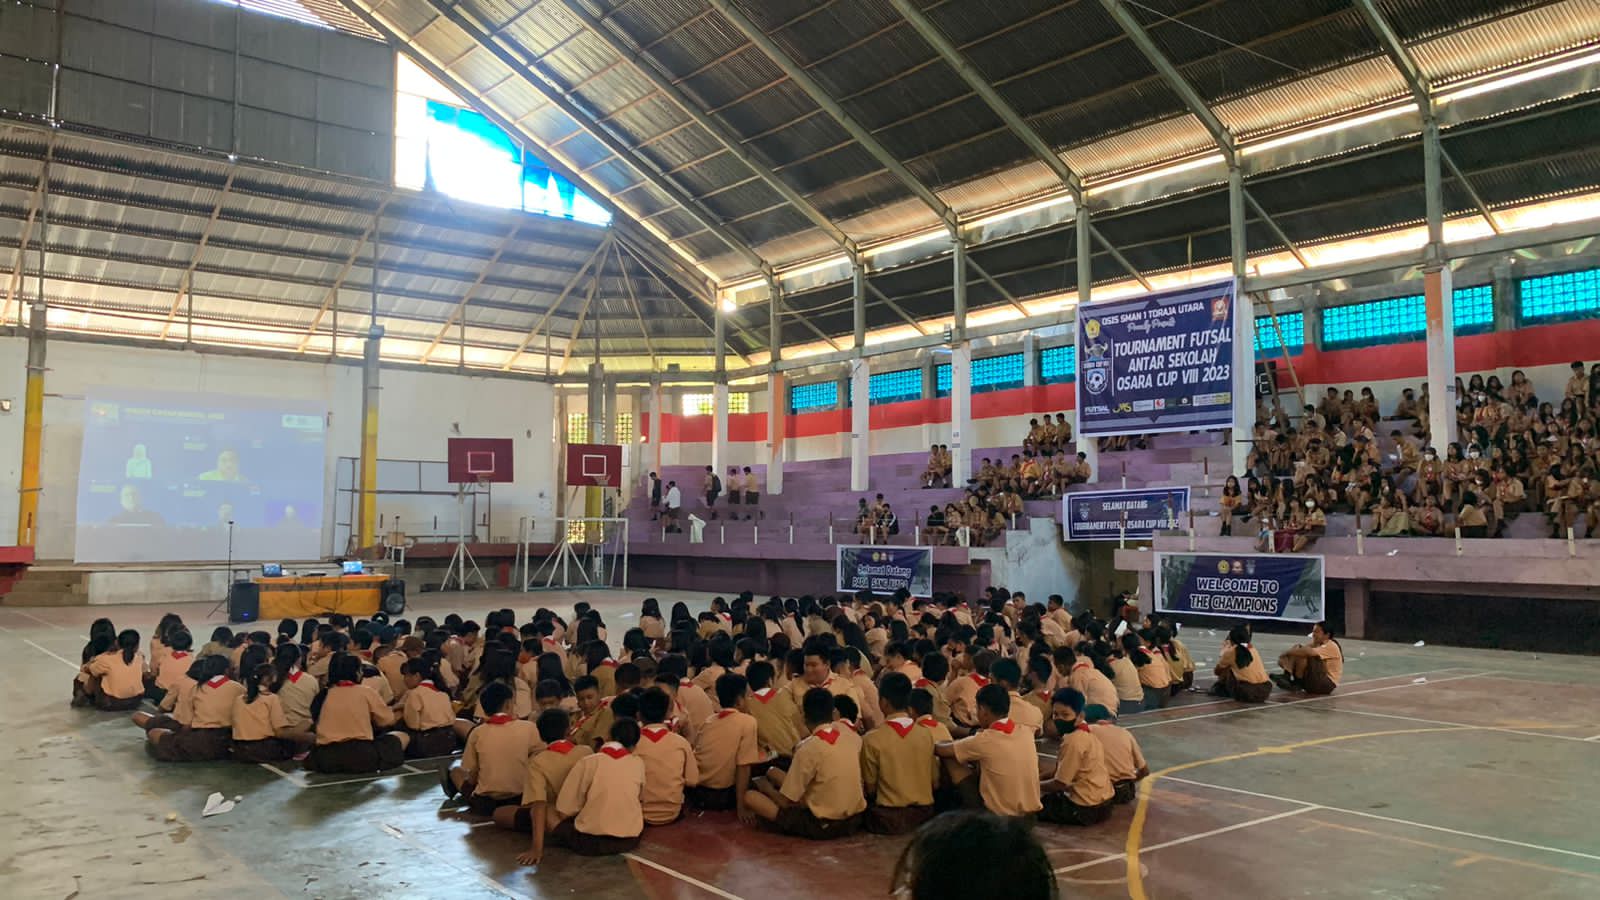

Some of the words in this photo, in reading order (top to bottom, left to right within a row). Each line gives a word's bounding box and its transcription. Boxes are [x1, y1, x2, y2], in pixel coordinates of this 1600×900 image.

[1102, 315, 1119, 326] OSIS
[1121, 313, 1142, 323] SMAN
[1143, 311, 1147, 320] 1
[1149, 308, 1176, 319] TORAJA
[1178, 302, 1204, 314] UTARA
[1114, 333, 1186, 357] TOURNAMENT
[1190, 327, 1232, 347] FUTSAL
[1128, 355, 1164, 373] ANTAR
[1168, 348, 1218, 368] SEKOLAH
[1117, 374, 1153, 391] OSARA
[1157, 372, 1178, 387] CUP
[1182, 369, 1199, 384] VIII
[1202, 365, 1230, 382] 2023
[1102, 501, 1126, 511] SELAMAT
[1073, 521, 1106, 531] TOURNAMENT
[1146, 519, 1157, 528] CUP
[858, 564, 885, 575] Selamat
[886, 565, 912, 578] Datang
[1197, 577, 1258, 593] WELCOME
[1260, 580, 1279, 594] TO
[1190, 594, 1210, 609] THE
[1211, 595, 1278, 613] CHAMPIONS
